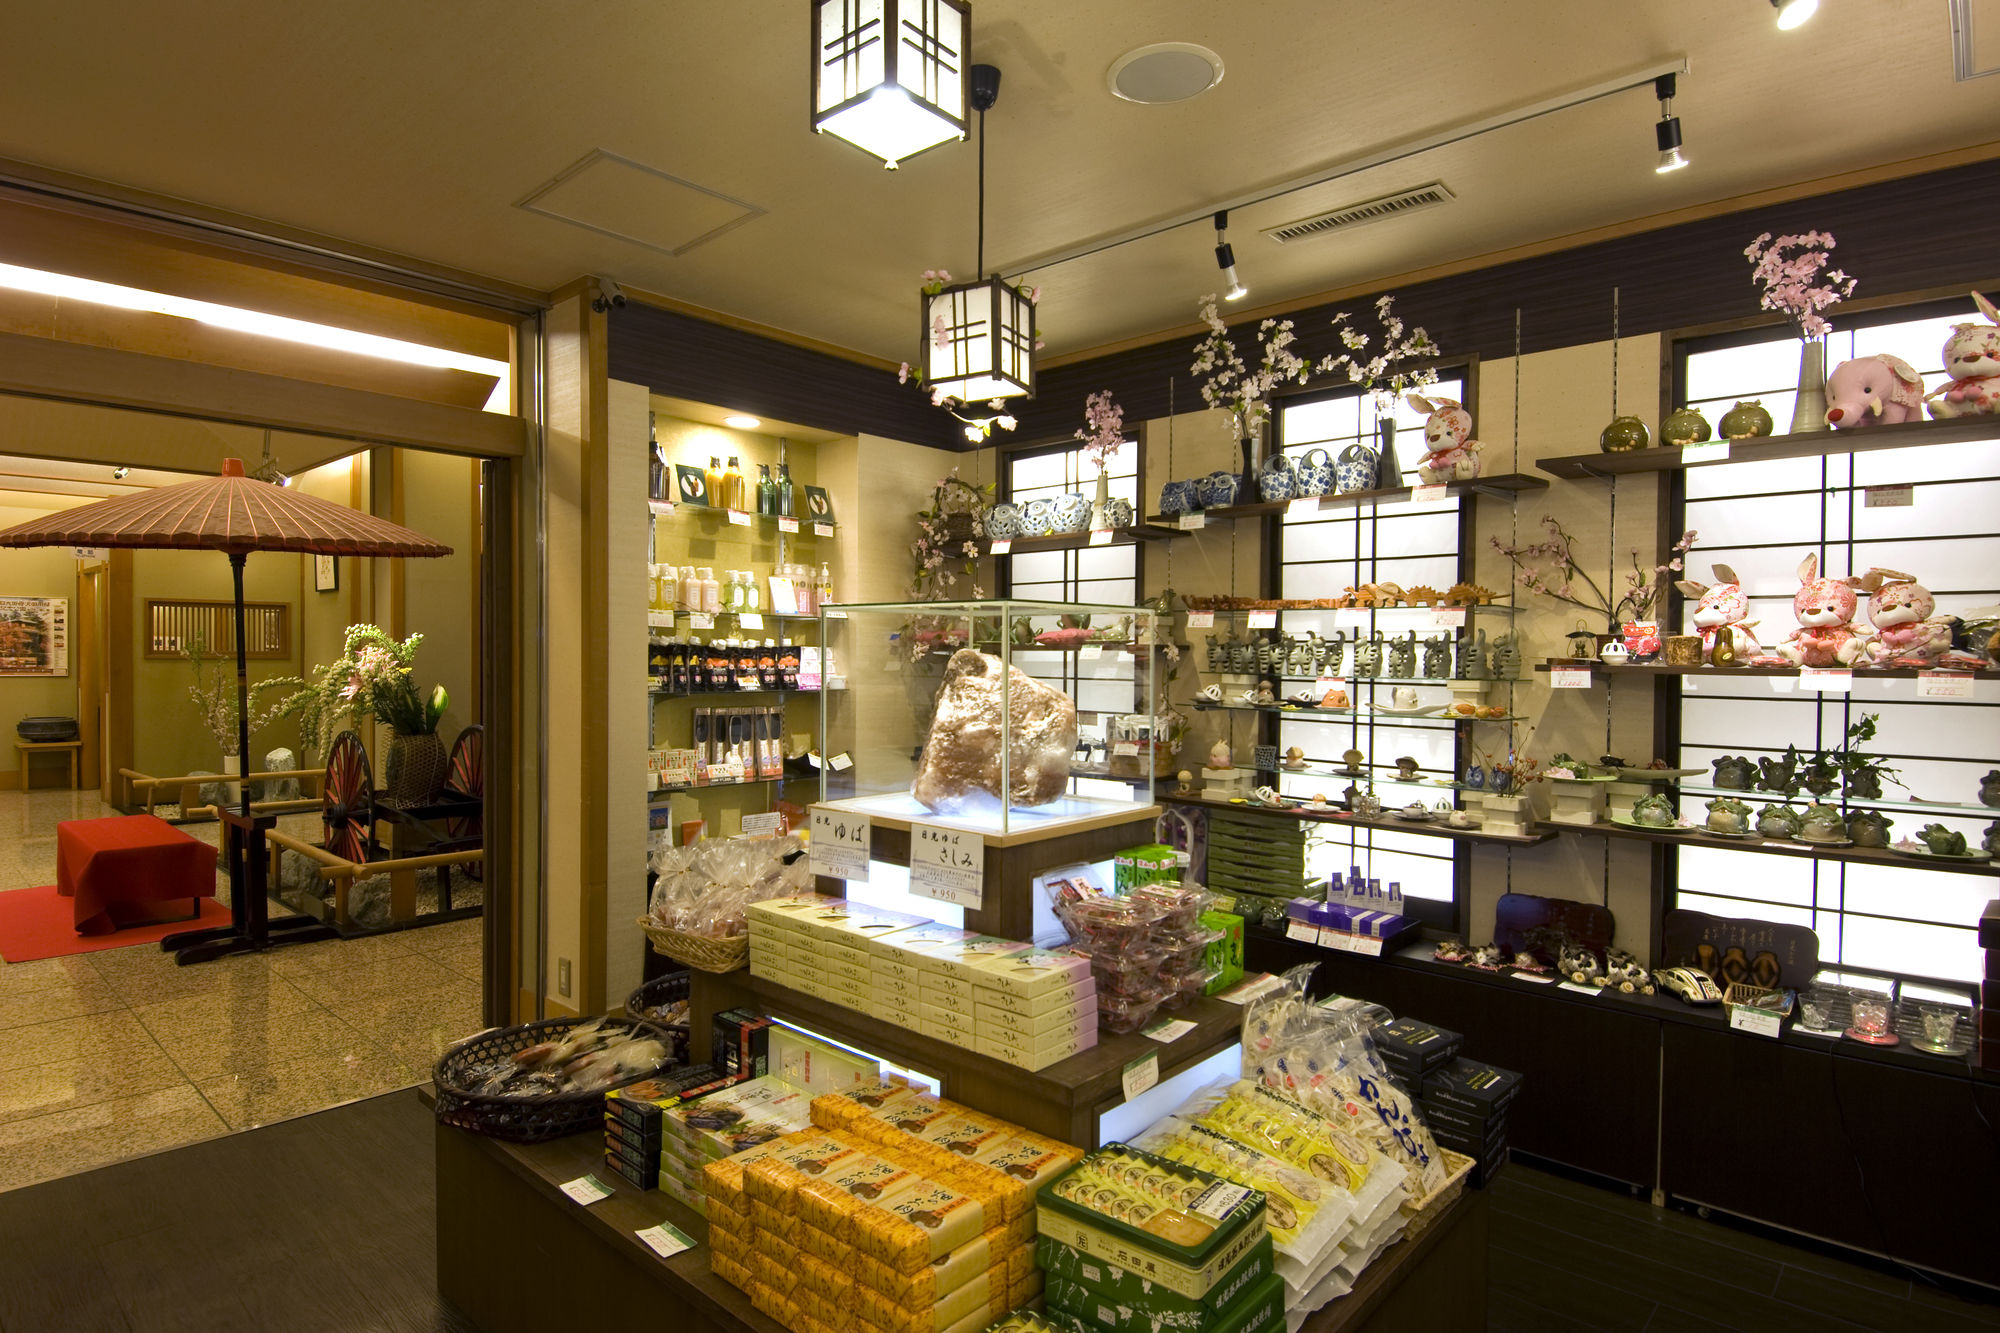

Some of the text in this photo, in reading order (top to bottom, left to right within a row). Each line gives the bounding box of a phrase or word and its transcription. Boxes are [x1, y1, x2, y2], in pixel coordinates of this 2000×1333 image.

[834, 822, 865, 844] ゆば
[921, 830, 960, 846] 日光ゆば
[939, 848, 974, 867] さしみ
